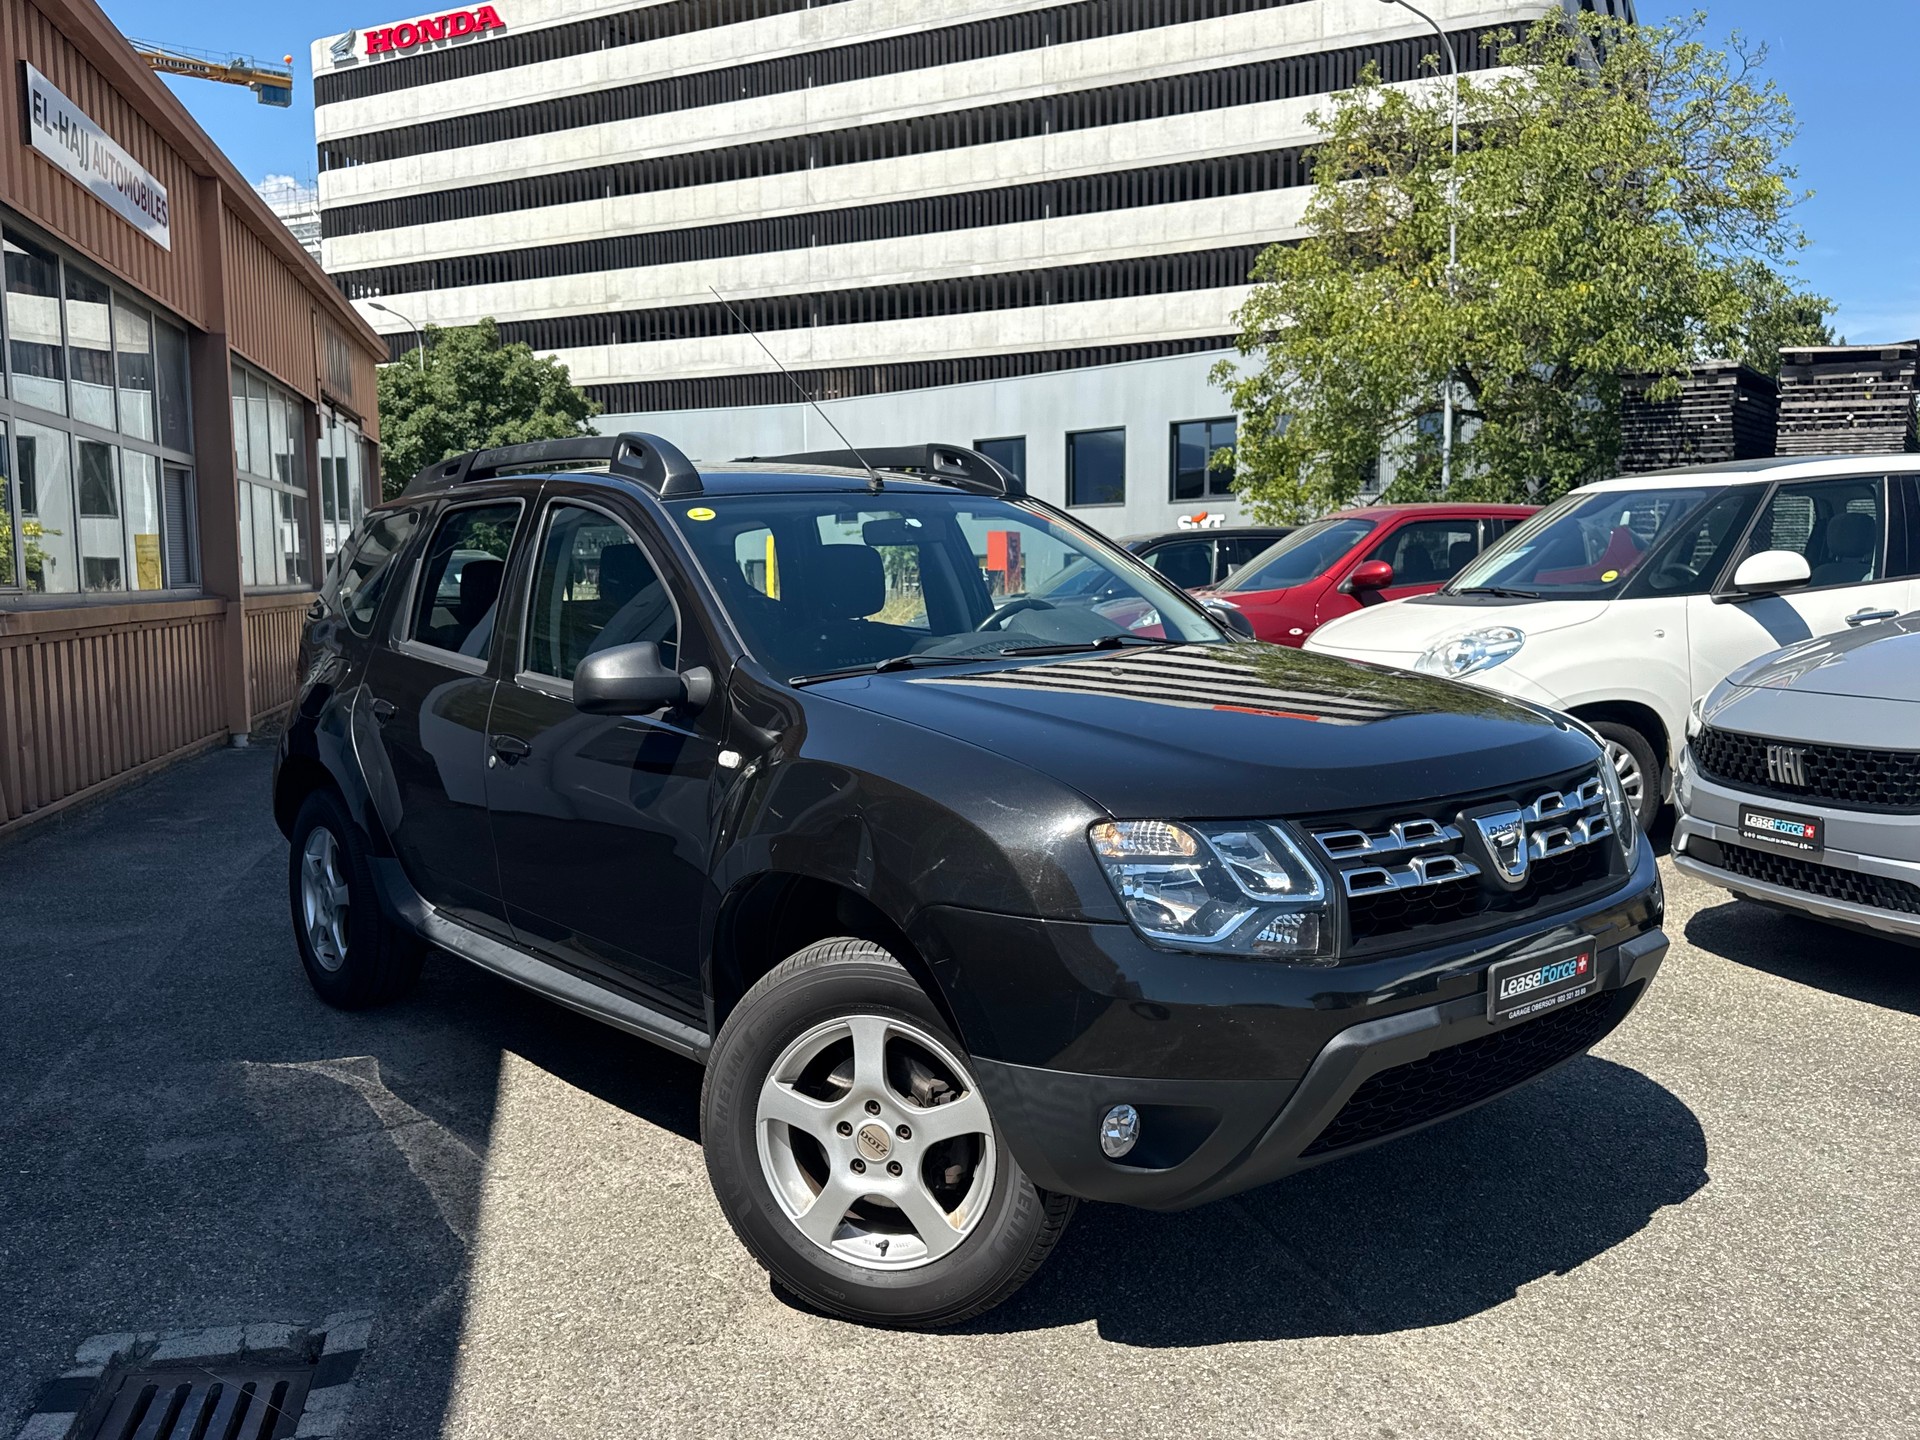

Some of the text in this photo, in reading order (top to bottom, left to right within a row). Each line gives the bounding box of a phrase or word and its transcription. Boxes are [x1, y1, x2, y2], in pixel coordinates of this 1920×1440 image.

[364, 5, 505, 54] HONDA
[33, 89, 168, 228] EL-HAJJ AUTOMOBILES
[1767, 745, 1806, 787] FIAT
[1745, 813, 1804, 834] LeaseForce
[1500, 960, 1577, 997] LeaseForce
[1509, 1006, 1531, 1019] GARAGE
[860, 1131, 888, 1156] DOTZ
